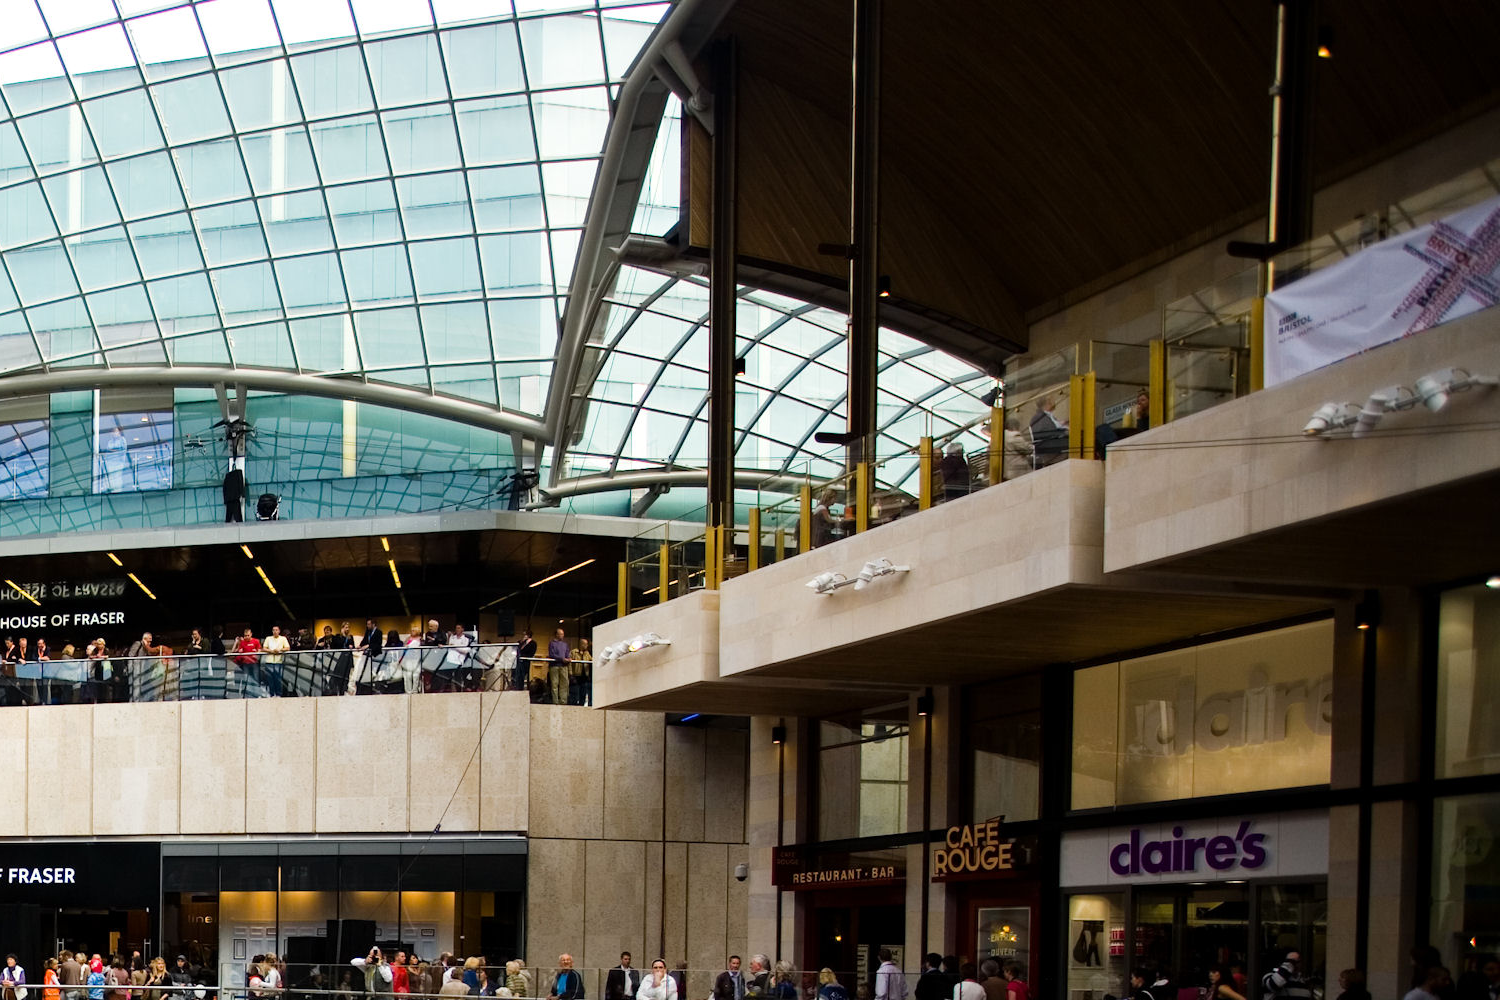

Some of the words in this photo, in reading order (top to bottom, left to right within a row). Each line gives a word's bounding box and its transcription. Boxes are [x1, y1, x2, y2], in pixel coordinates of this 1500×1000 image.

[1278, 316, 1312, 335] BRISTOL
[0, 615, 47, 629] HOUSE
[51, 614, 70, 626] OF
[74, 612, 125, 626] FRASER
[1109, 820, 1267, 876] claire's
[934, 843, 1013, 875] ROUGE
[8, 867, 76, 884] FRASER
[792, 867, 862, 884] RESTAURANT
[871, 866, 895, 879] BAR
